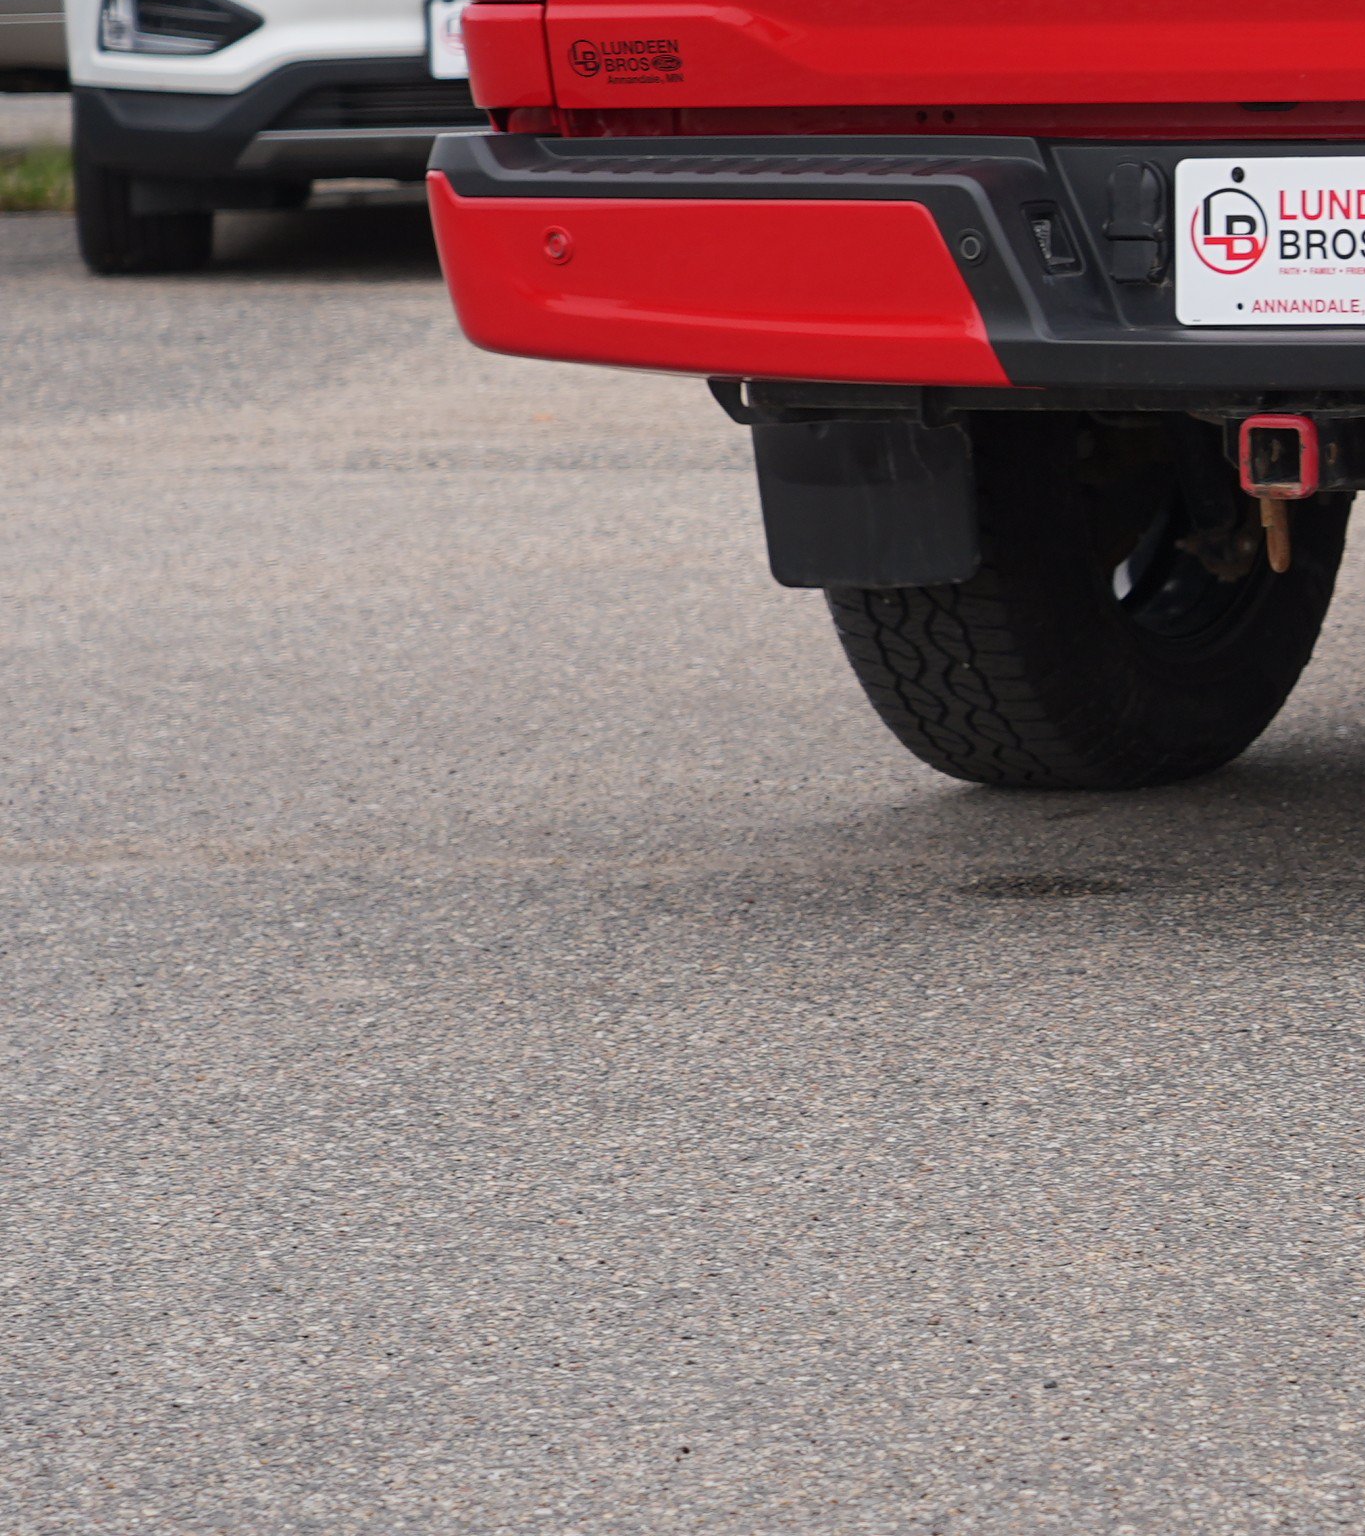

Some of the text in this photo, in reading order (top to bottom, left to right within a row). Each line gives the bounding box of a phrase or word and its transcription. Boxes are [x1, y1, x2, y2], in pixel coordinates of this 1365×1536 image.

[601, 39, 679, 55] LUNDEEN
[604, 57, 650, 72] BROS
[1251, 299, 1365, 315] ANNANDALE,
